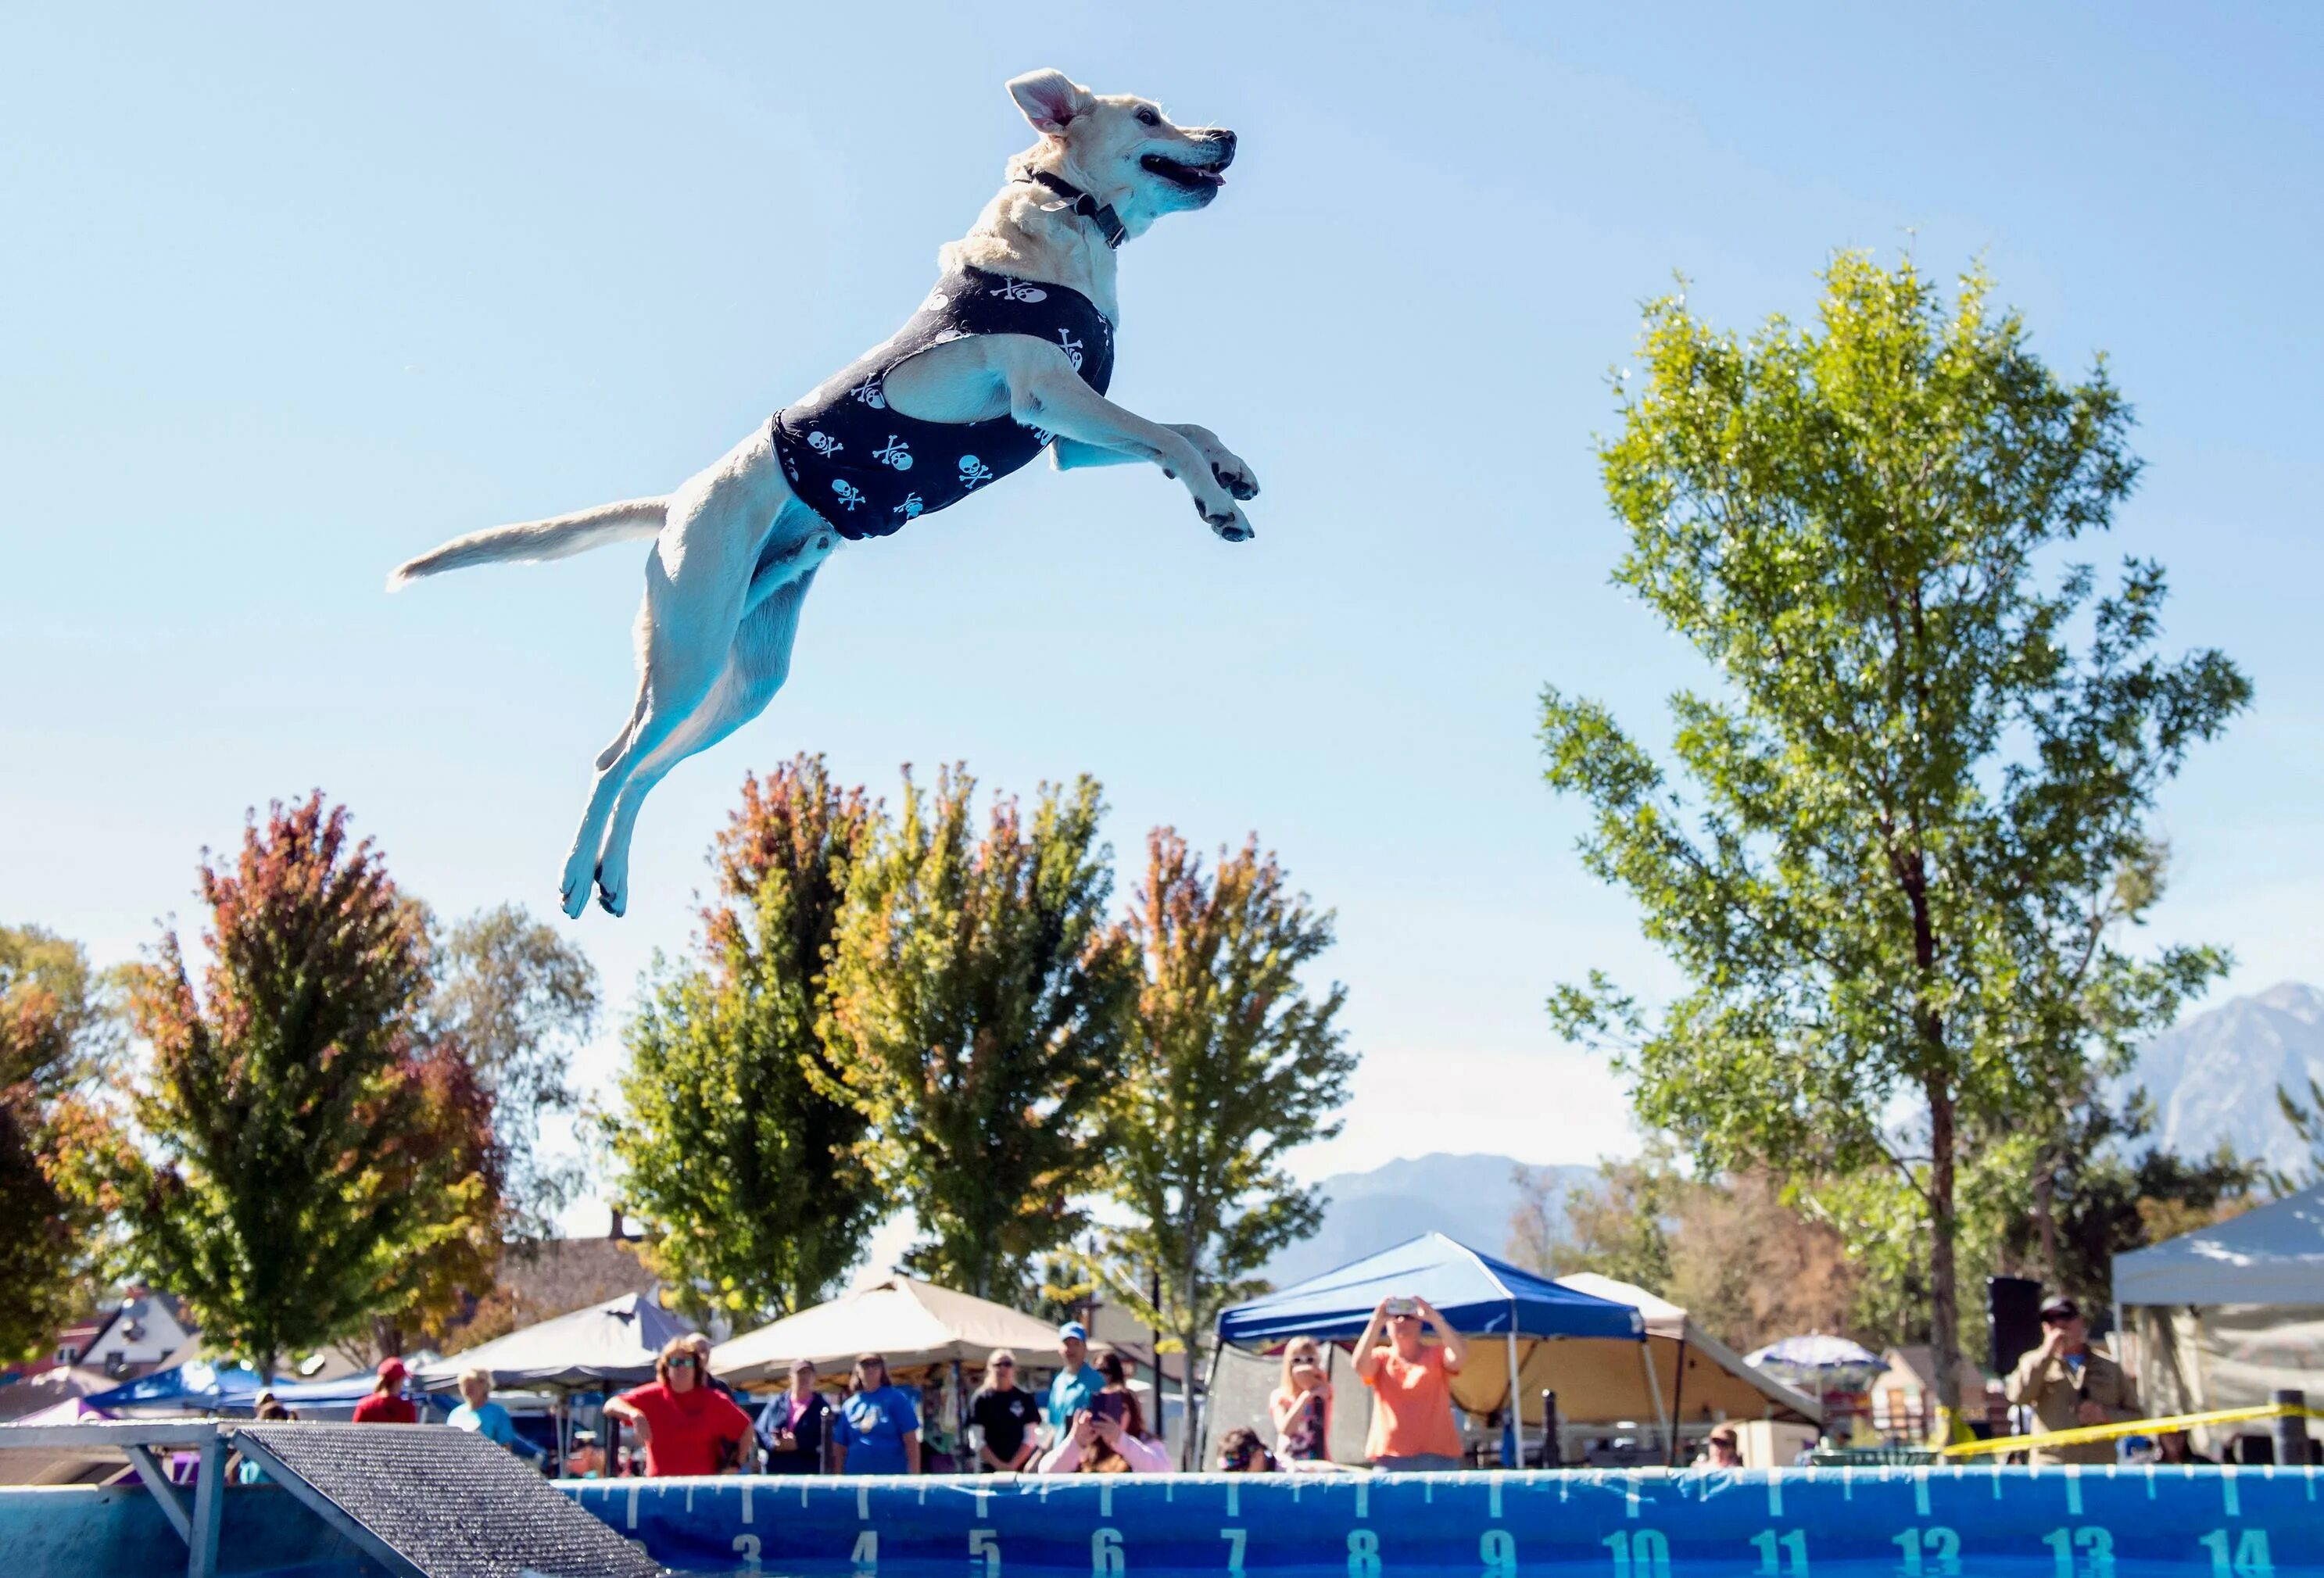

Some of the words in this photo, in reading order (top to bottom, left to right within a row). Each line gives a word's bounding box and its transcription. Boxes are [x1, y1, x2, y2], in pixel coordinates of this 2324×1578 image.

[732, 1533, 763, 1577] 3
[850, 1530, 878, 1577] 4
[969, 1529, 1001, 1578] 5
[1091, 1527, 1126, 1578] 6
[1220, 1529, 1247, 1578] 7
[1347, 1529, 1382, 1578] 8
[1480, 1529, 1517, 1578] 9
[1602, 1529, 1671, 1578] 10
[1749, 1529, 1809, 1578] 11
[2042, 1526, 2115, 1578] 13
[2199, 1529, 2276, 1578] 14
